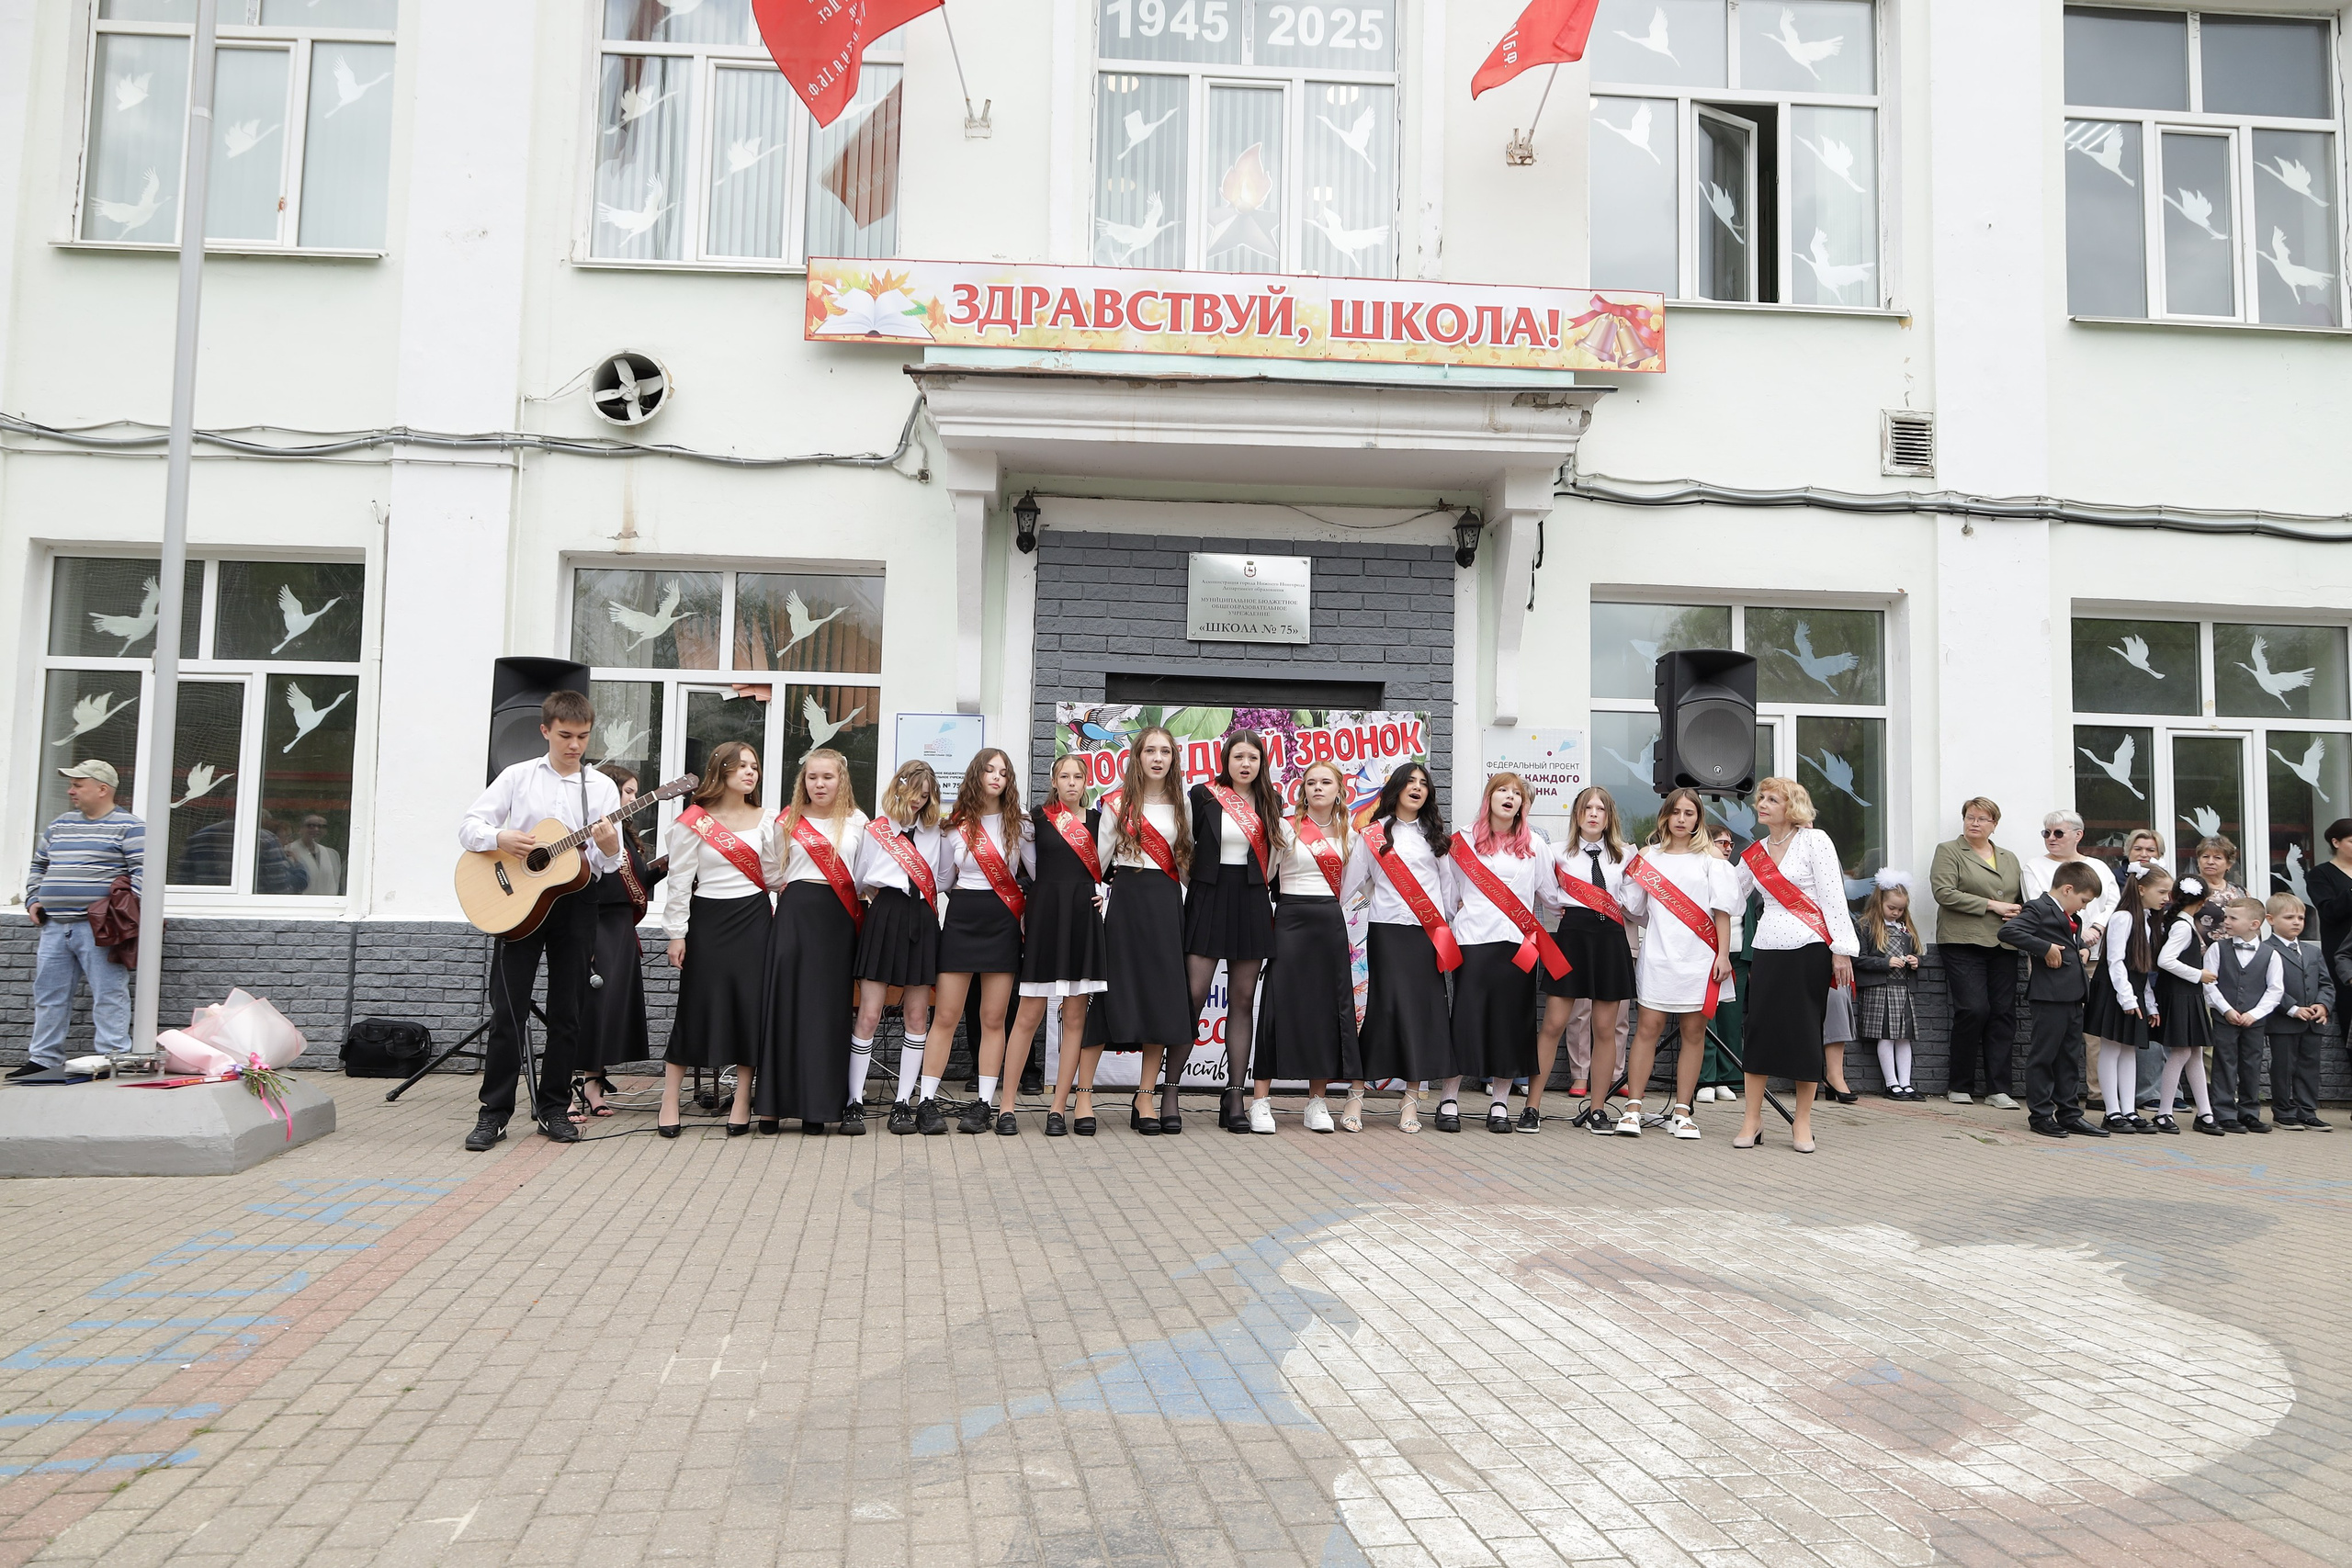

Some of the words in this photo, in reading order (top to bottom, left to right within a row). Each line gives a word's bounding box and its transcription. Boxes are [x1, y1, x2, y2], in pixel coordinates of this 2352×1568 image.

[1106, 0, 1229, 42] 1945
[1267, 6, 1385, 51] 2025
[948, 283, 1310, 345] ЗДРАВСТВУЙ,
[1329, 299, 1560, 348] ШКОЛА!
[1295, 721, 1424, 766] ЗВОНОК
[1486, 761, 1547, 770] ФЕДЕРАЛЬНЫЙ
[1548, 762, 1580, 771] ПРОЕКТ
[1524, 774, 1580, 784] КАЖДОГО
[876, 823, 926, 882] Выпускница
[1408, 890, 1440, 923] 2025
[1462, 856, 1511, 908] Выпускница
[1642, 871, 1698, 923] Выпускница
